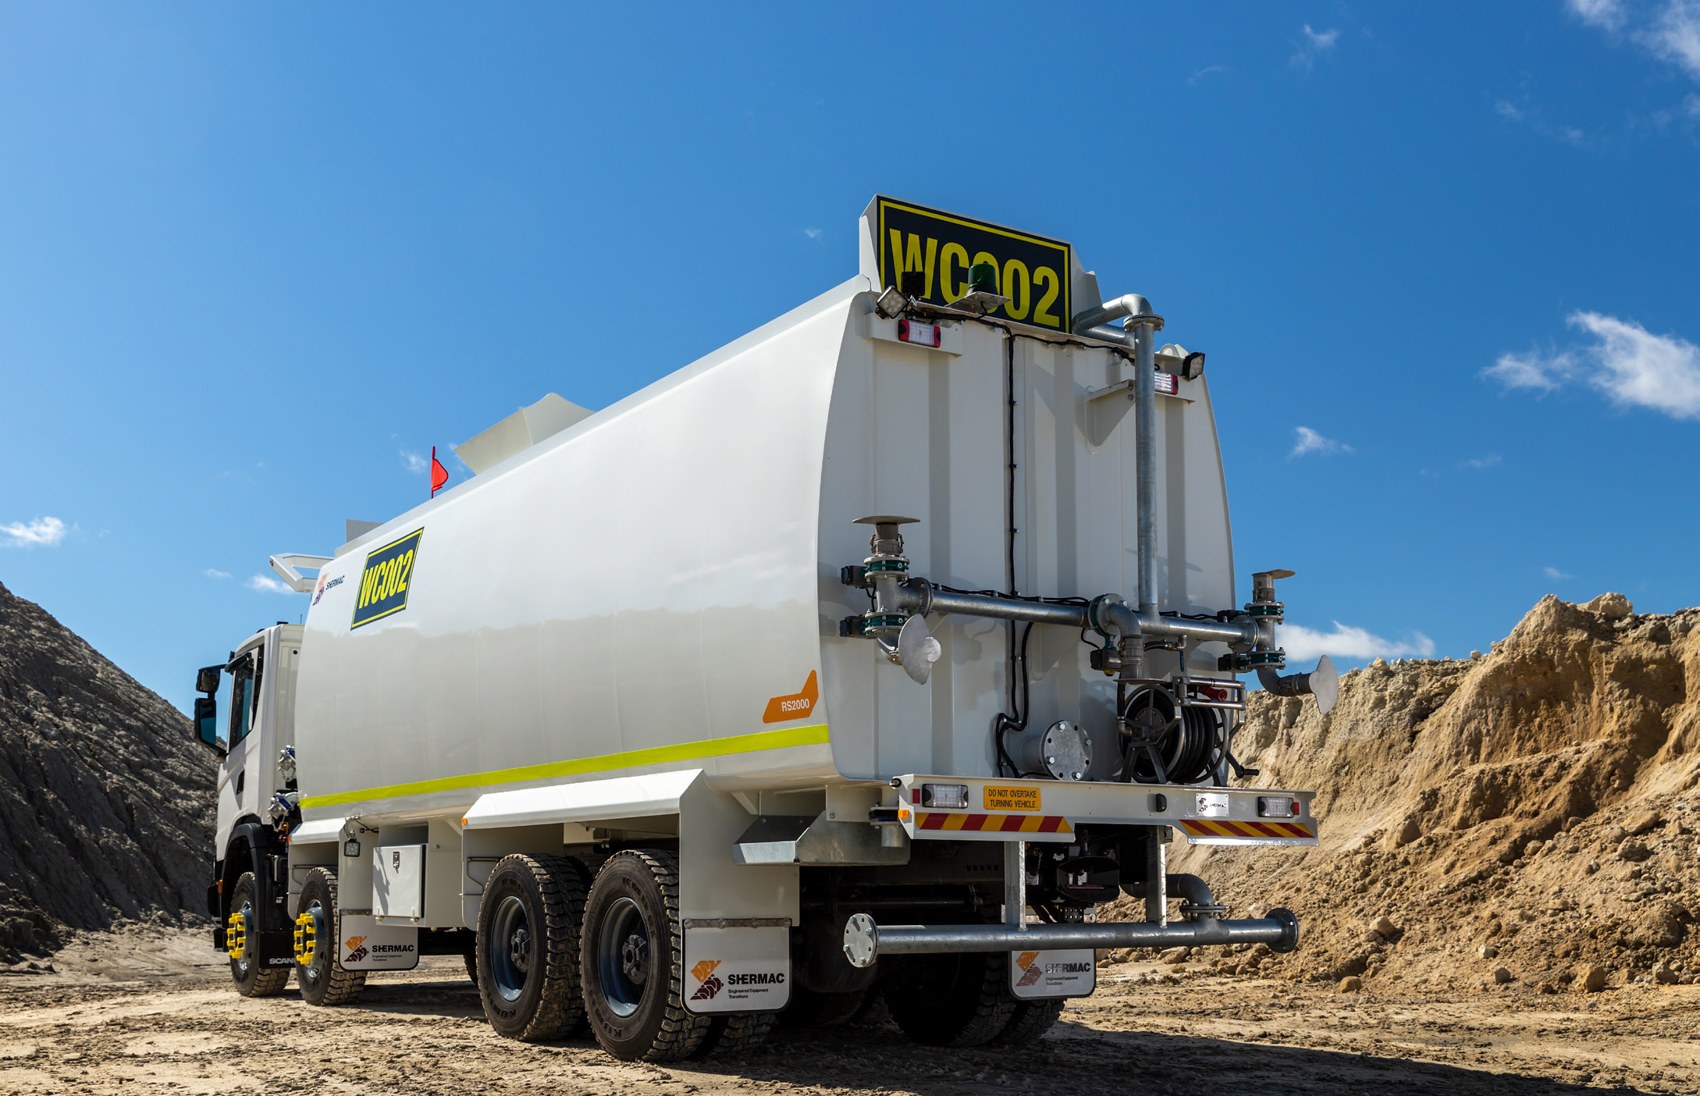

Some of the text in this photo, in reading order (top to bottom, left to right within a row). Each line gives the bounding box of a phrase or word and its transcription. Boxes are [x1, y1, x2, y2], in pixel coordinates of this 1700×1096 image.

[359, 549, 414, 609] WC002
[781, 698, 810, 712] RS2000
[988, 789, 1037, 798] DO NOT OVERTAKE
[990, 799, 1036, 809] TURNING VEHICLE
[372, 944, 414, 952] SHERMAC
[1045, 962, 1090, 973] SHERMAC
[727, 973, 785, 985] SHERMAC
